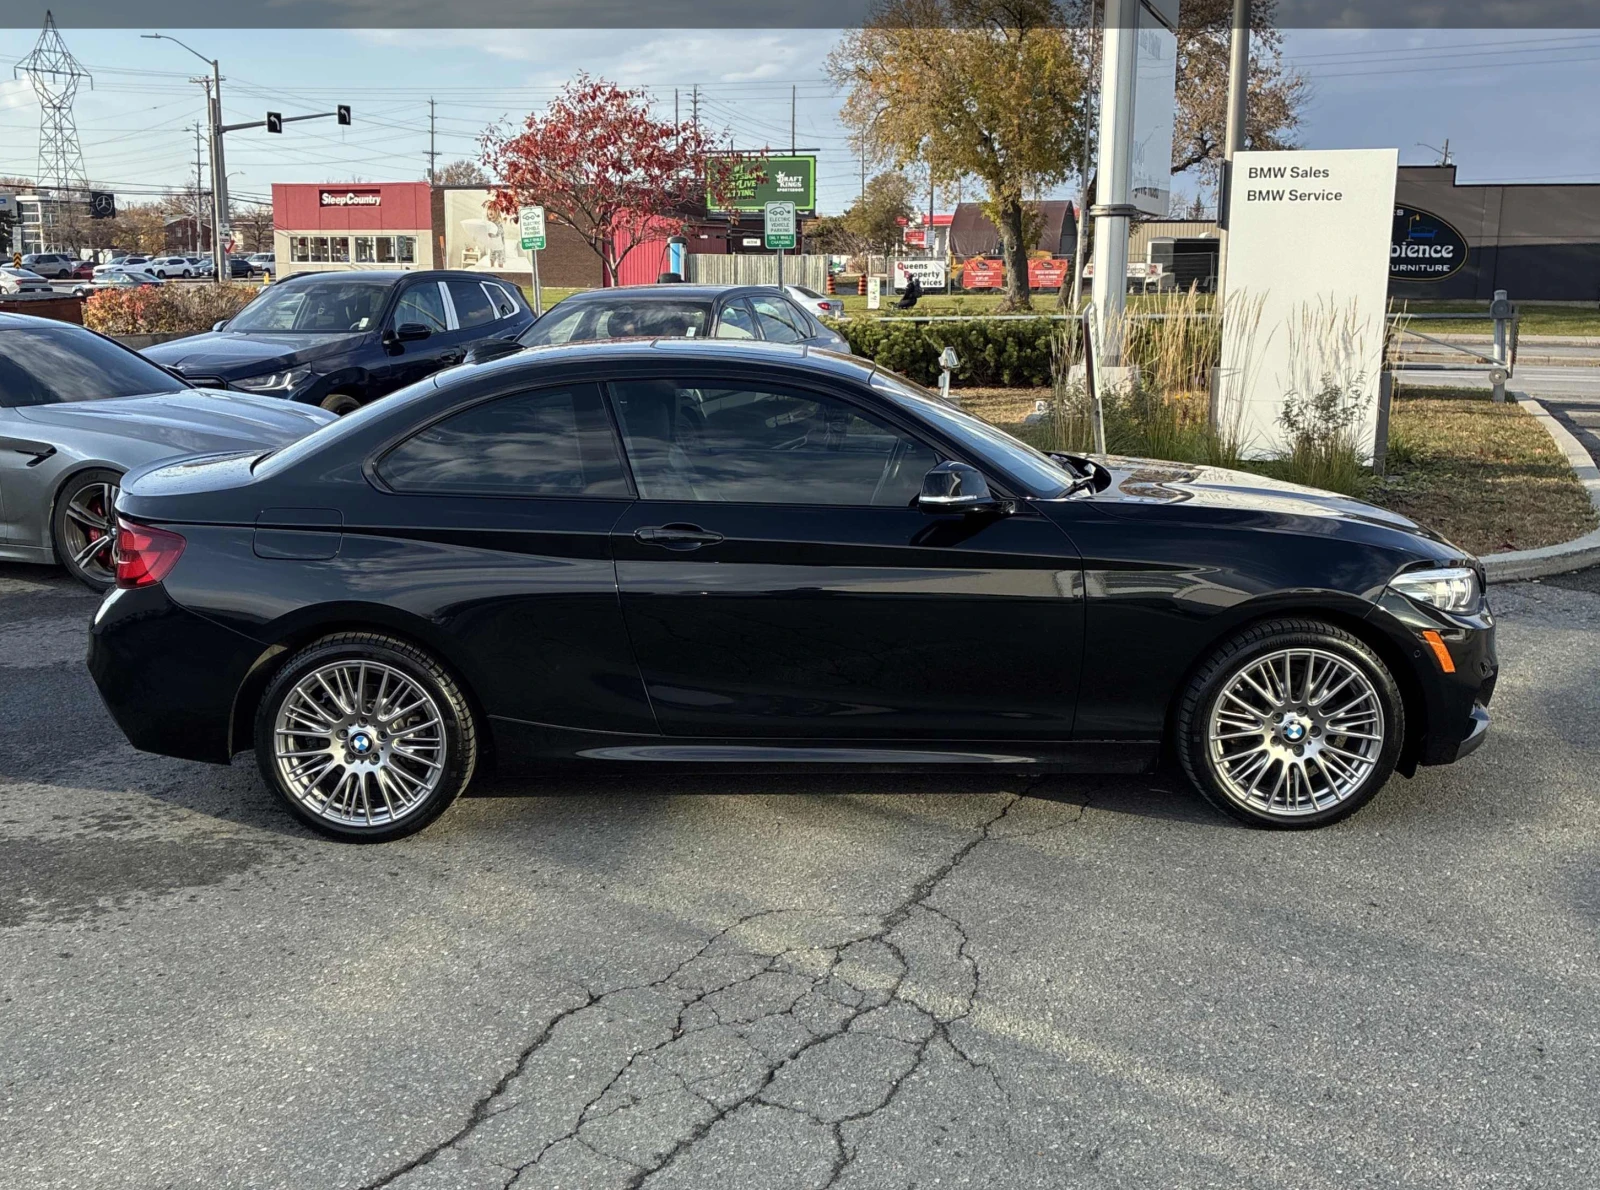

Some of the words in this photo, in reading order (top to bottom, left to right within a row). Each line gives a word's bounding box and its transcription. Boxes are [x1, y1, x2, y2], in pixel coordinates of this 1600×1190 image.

[1248, 167, 1287, 178] BMW
[1290, 166, 1330, 178] Sales
[1247, 189, 1285, 201] BMW
[1288, 189, 1343, 201] Service
[1390, 242, 1454, 258] bience
[897, 262, 928, 270] Queens
